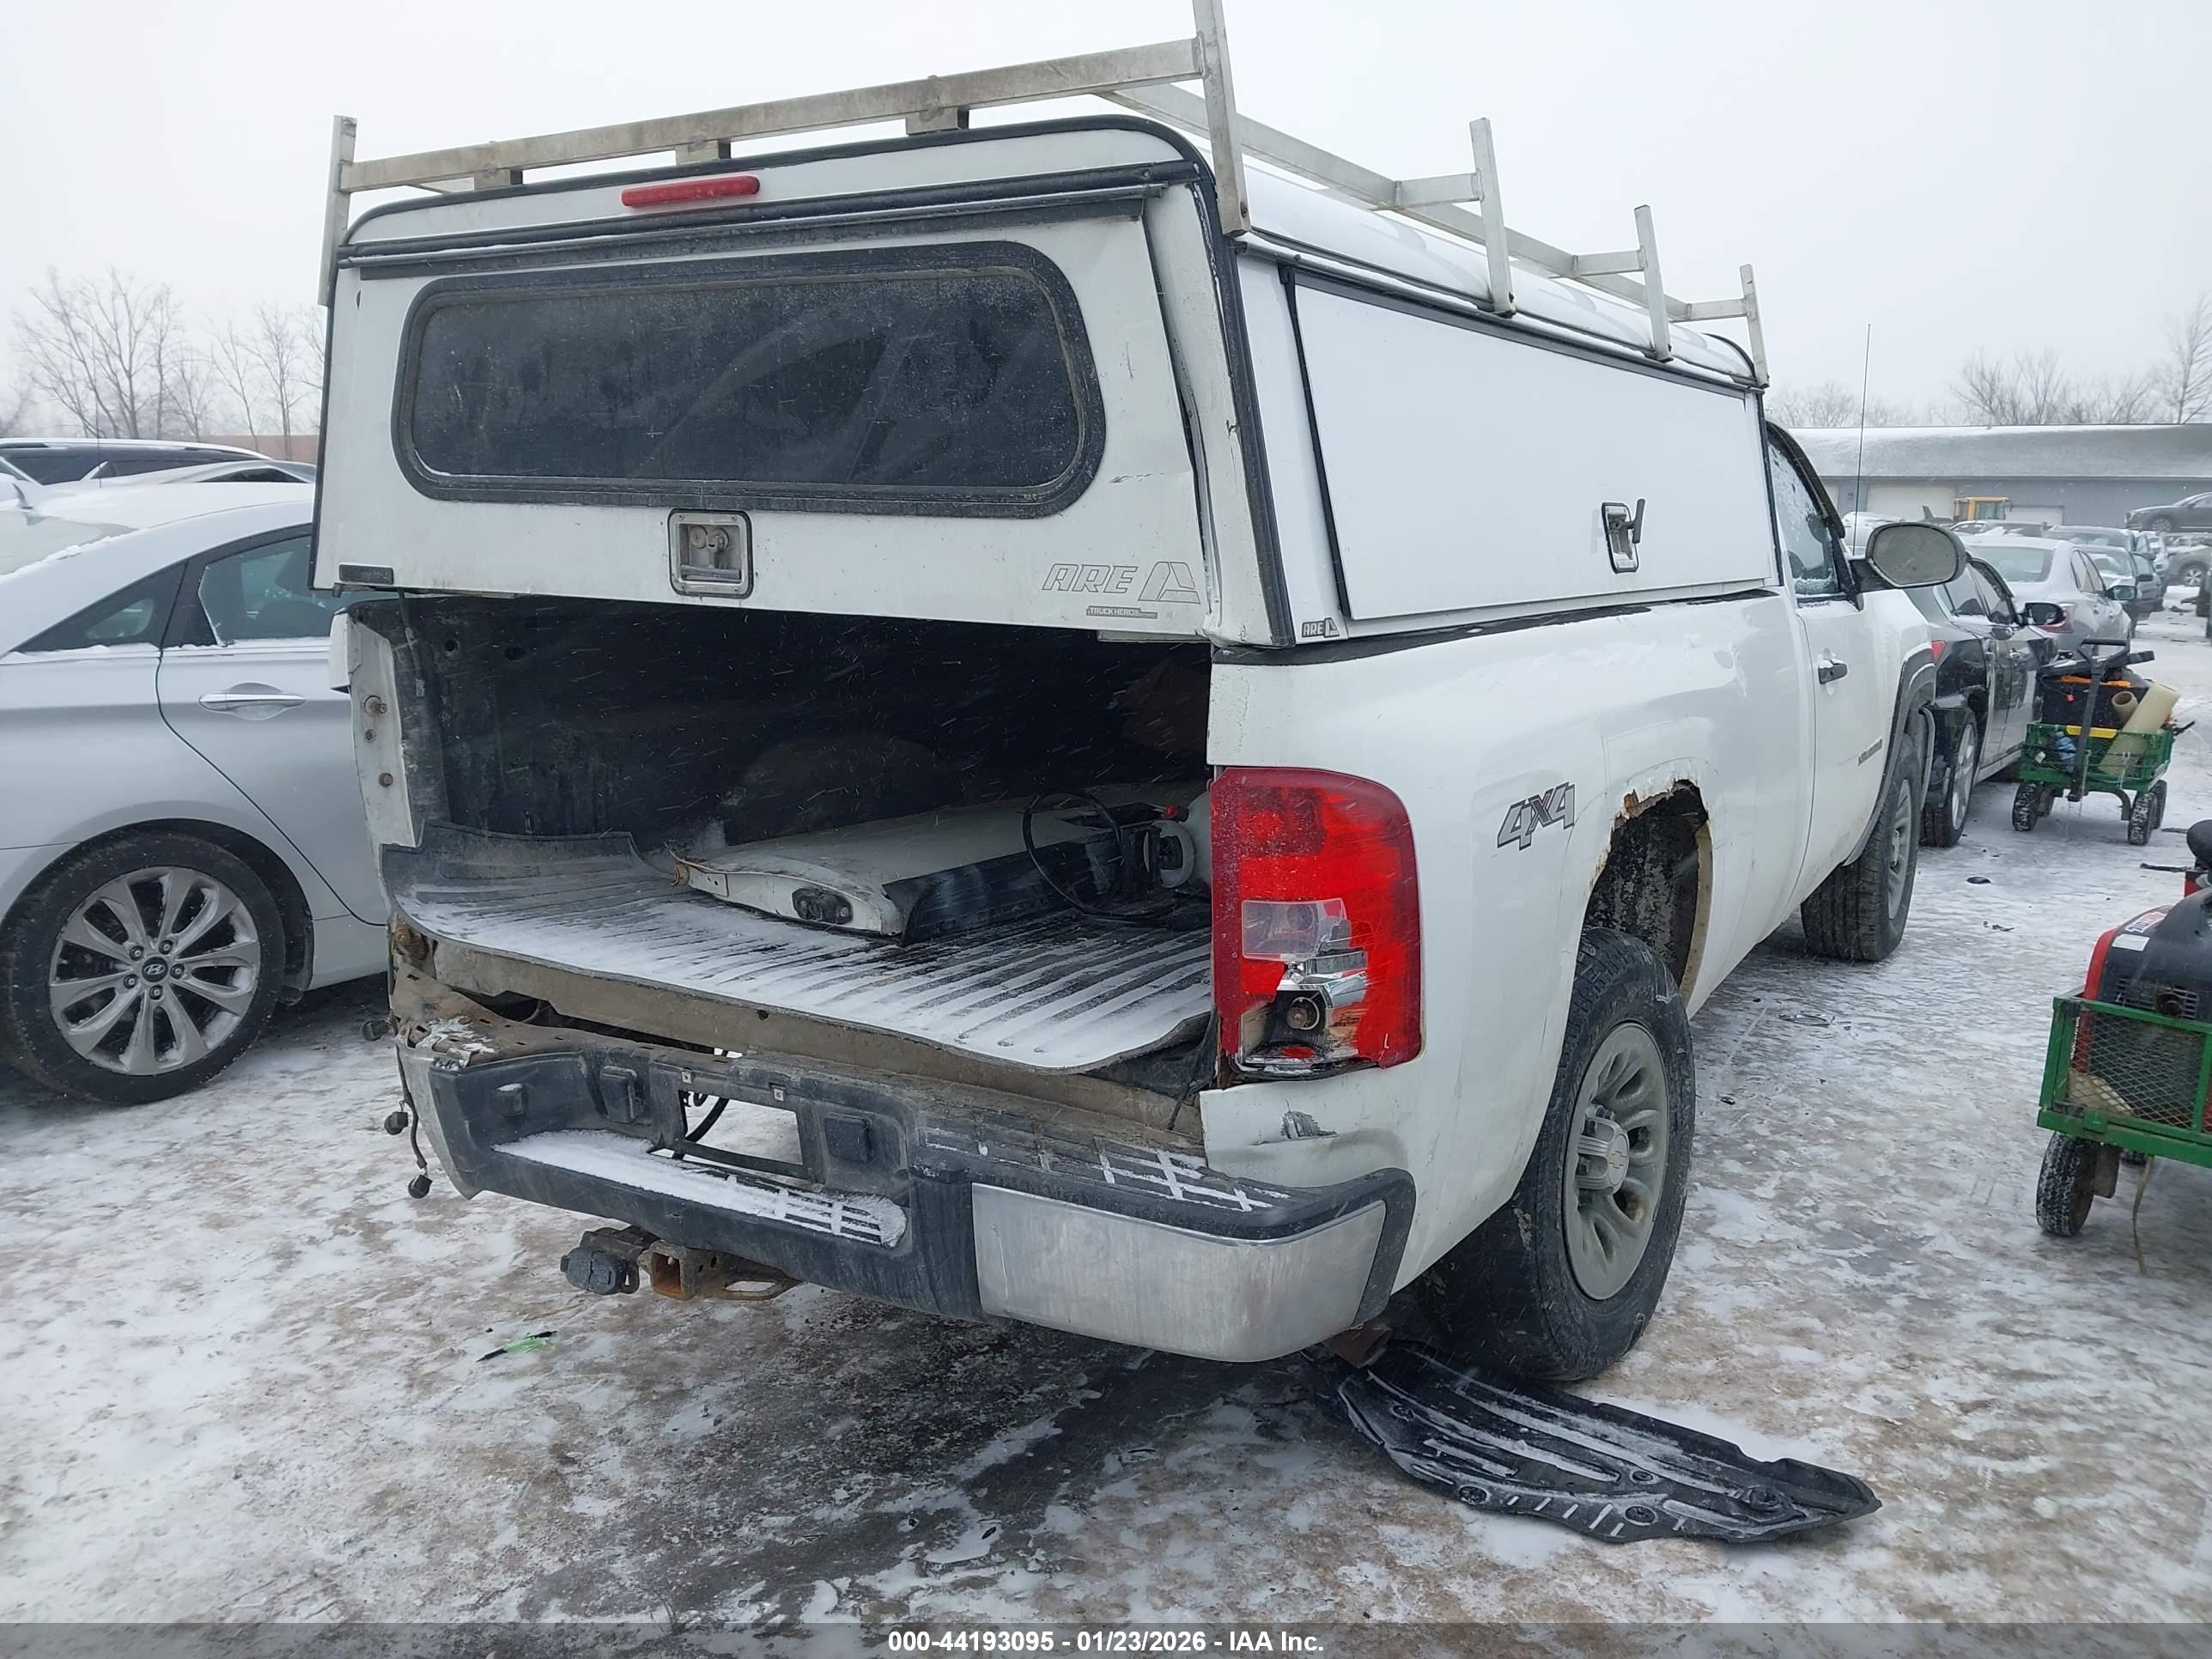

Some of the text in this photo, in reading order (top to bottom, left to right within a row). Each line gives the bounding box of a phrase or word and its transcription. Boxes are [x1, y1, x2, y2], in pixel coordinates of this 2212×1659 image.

[1042, 563, 1139, 594] ARE
[1090, 606, 1114, 617] TRUCK
[1303, 622, 1324, 637] ARE
